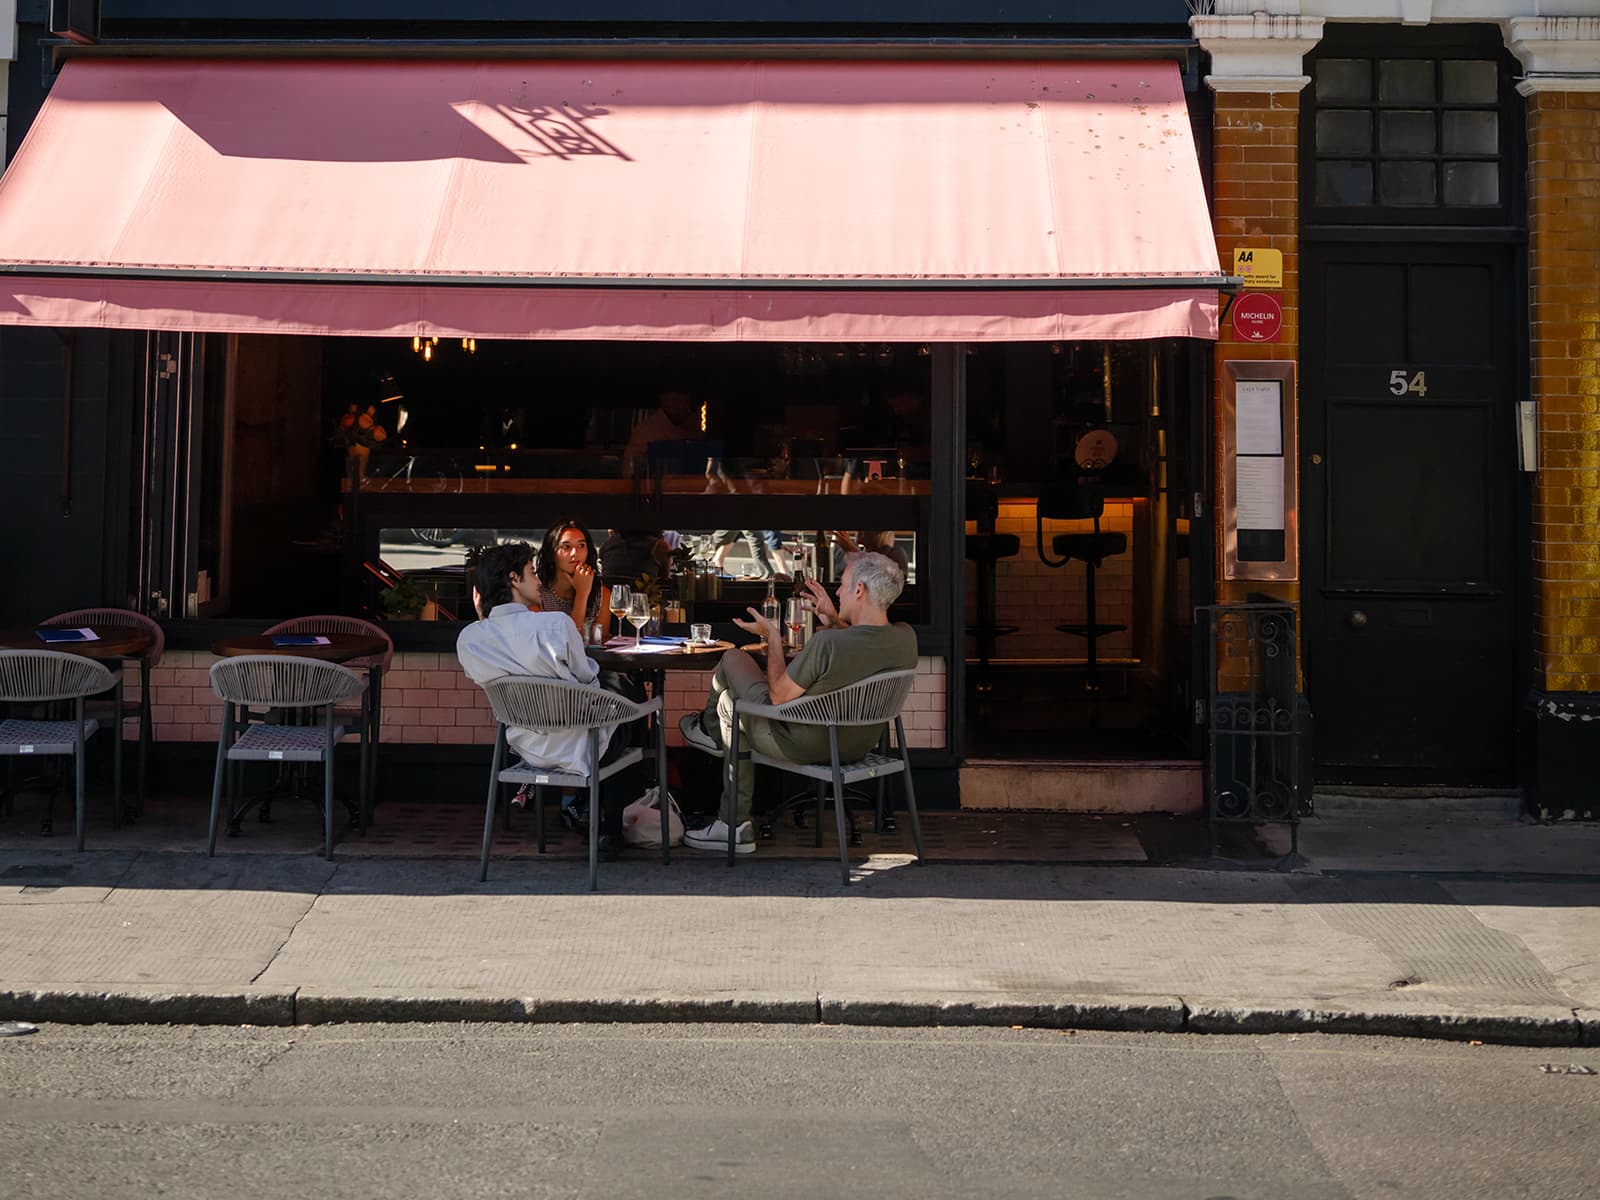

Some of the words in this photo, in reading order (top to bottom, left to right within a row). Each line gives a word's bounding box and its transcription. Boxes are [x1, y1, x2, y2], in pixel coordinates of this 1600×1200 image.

[1238, 251, 1253, 262] AA
[1241, 312, 1274, 320] MICHELIN
[1389, 370, 1427, 397] 54
